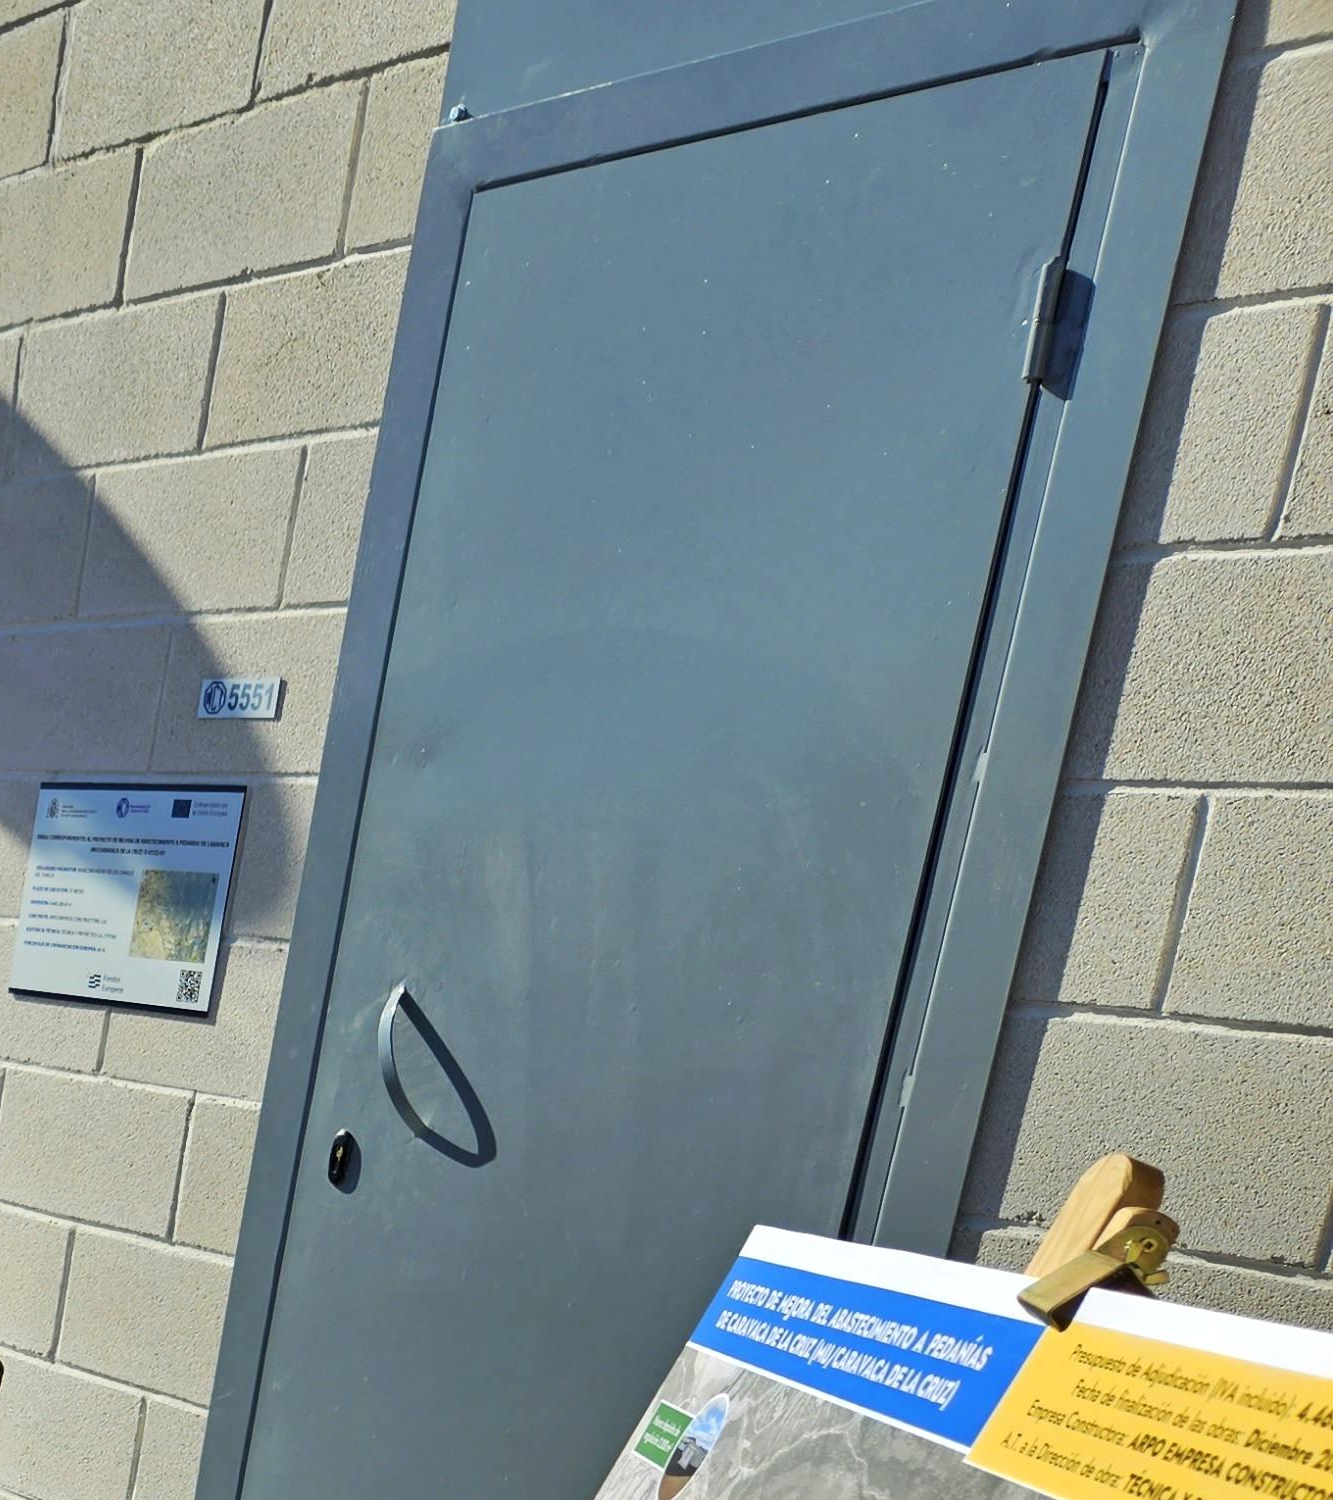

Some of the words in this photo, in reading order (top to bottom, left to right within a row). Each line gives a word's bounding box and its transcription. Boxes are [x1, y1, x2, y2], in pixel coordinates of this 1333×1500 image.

[228, 682, 275, 711] 5551
[715, 1309, 734, 1329] DE
[724, 1312, 770, 1343] CARAVACA
[726, 1279, 770, 1306] PROYECTO
[763, 1289, 783, 1310] DE
[775, 1293, 815, 1321] MEJORA
[809, 1302, 833, 1325] DEL
[826, 1307, 918, 1349] ABASTECIMIENTO
[910, 1330, 929, 1353] A
[923, 1333, 993, 1371] PEDANÍAS
[763, 1325, 785, 1347] DE
[775, 1329, 795, 1351] LA
[787, 1333, 818, 1358] CRUZ
[883, 1363, 909, 1388] DE
[898, 1368, 921, 1394] LA
[1069, 1342, 1126, 1373] Presupuesto
[1124, 1357, 1142, 1377] de
[1139, 1363, 1210, 1394] Adjudicación
[1207, 1377, 1239, 1402] (IVA
[1236, 1385, 1296, 1420] incluido):
[1297, 1399, 1333, 1432] 4.46
[914, 1373, 960, 1411] CRUZ)
[1071, 1378, 1101, 1402] Fecha
[1099, 1391, 1116, 1406] de
[1115, 1388, 1173, 1422] finalización
[1171, 1407, 1190, 1428] de
[1187, 1410, 1207, 1434] las
[1205, 1417, 1245, 1444] obras:
[1243, 1427, 1314, 1465] Diciembre
[1026, 1398, 1066, 1426] Empresa
[1065, 1410, 1127, 1446] Constructora:
[1127, 1433, 1166, 1457] ARPO
[1161, 1442, 1224, 1477] EMPRESA
[1018, 1441, 1028, 1453] a
[1026, 1438, 1038, 1457] la
[1035, 1441, 1081, 1472] Dirección
[1079, 1457, 1095, 1478] de
[1093, 1463, 1123, 1488] obra:
